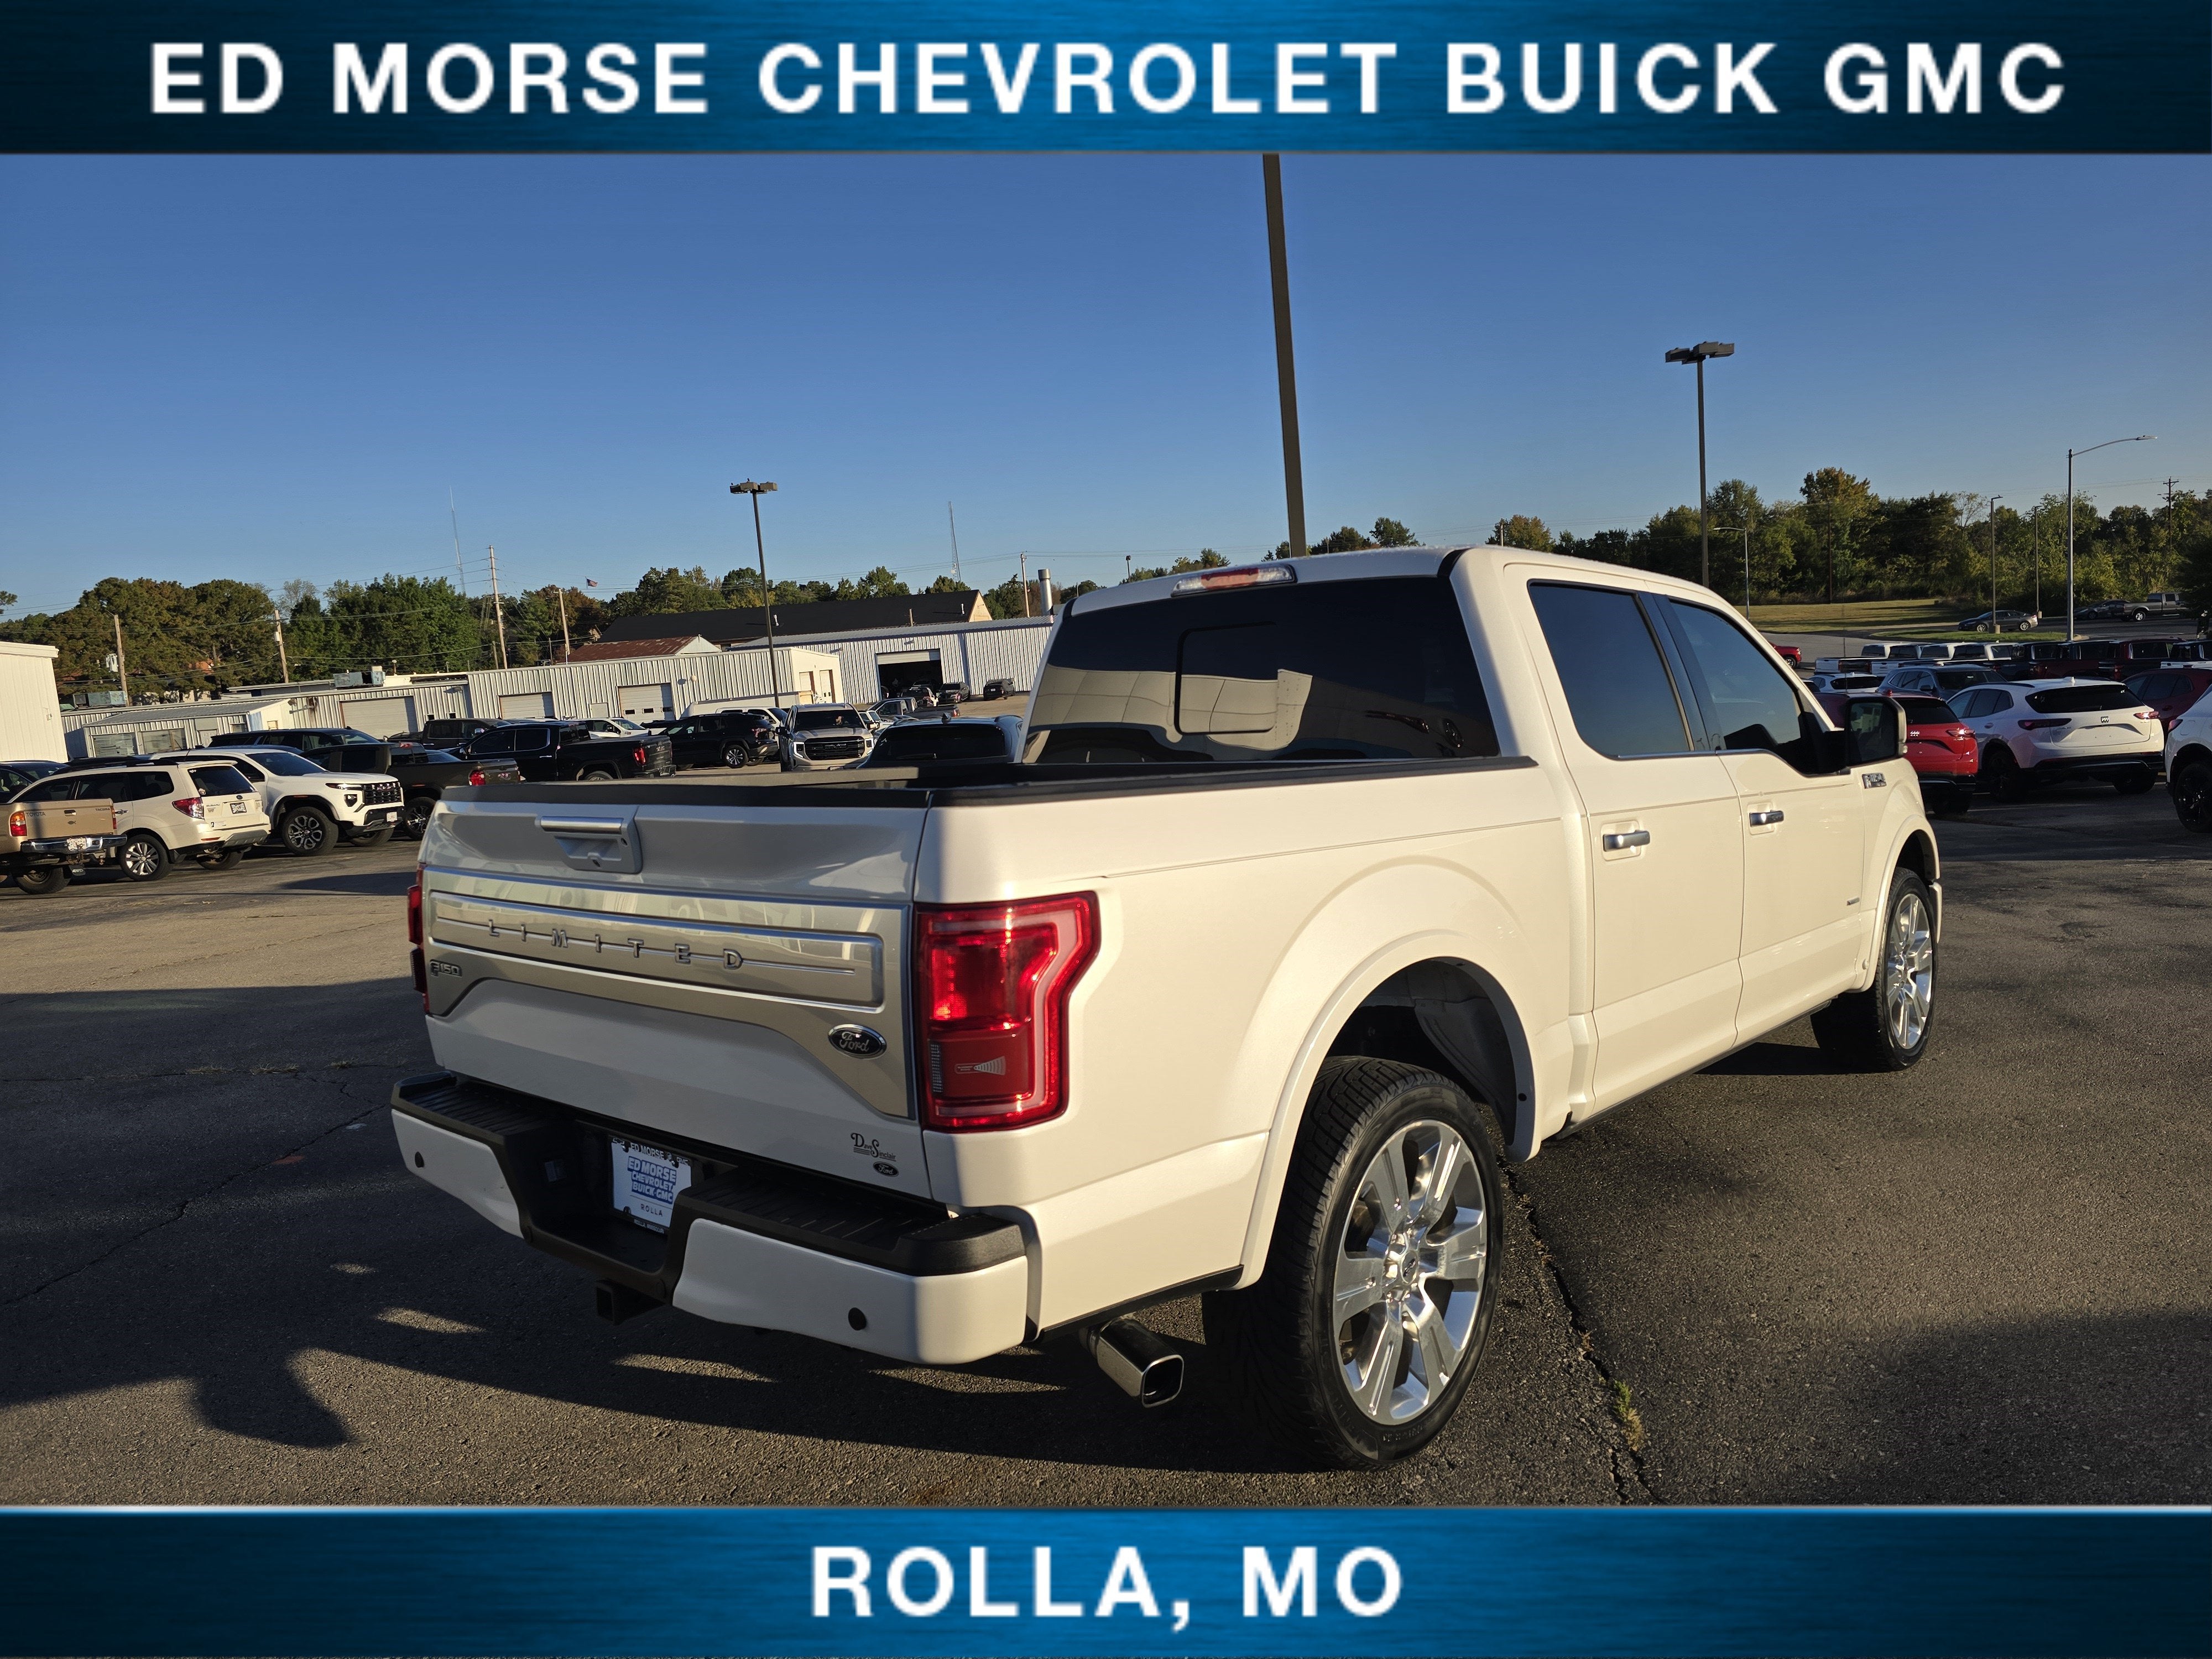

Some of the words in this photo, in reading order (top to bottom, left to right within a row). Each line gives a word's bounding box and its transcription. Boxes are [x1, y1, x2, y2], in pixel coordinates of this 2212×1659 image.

[488, 919, 743, 971] LIMITED
[839, 1031, 870, 1052] Ford
[630, 1142, 639, 1151] ED
[641, 1145, 664, 1159] MORSE
[851, 1133, 873, 1150] Dave
[870, 1139, 896, 1159] Sinclair
[628, 1157, 641, 1171] ED
[641, 1160, 677, 1183] MORSE
[878, 1164, 893, 1175] Ford
[632, 1171, 674, 1193] CHEVROLET
[640, 1203, 663, 1217] ROLLA
